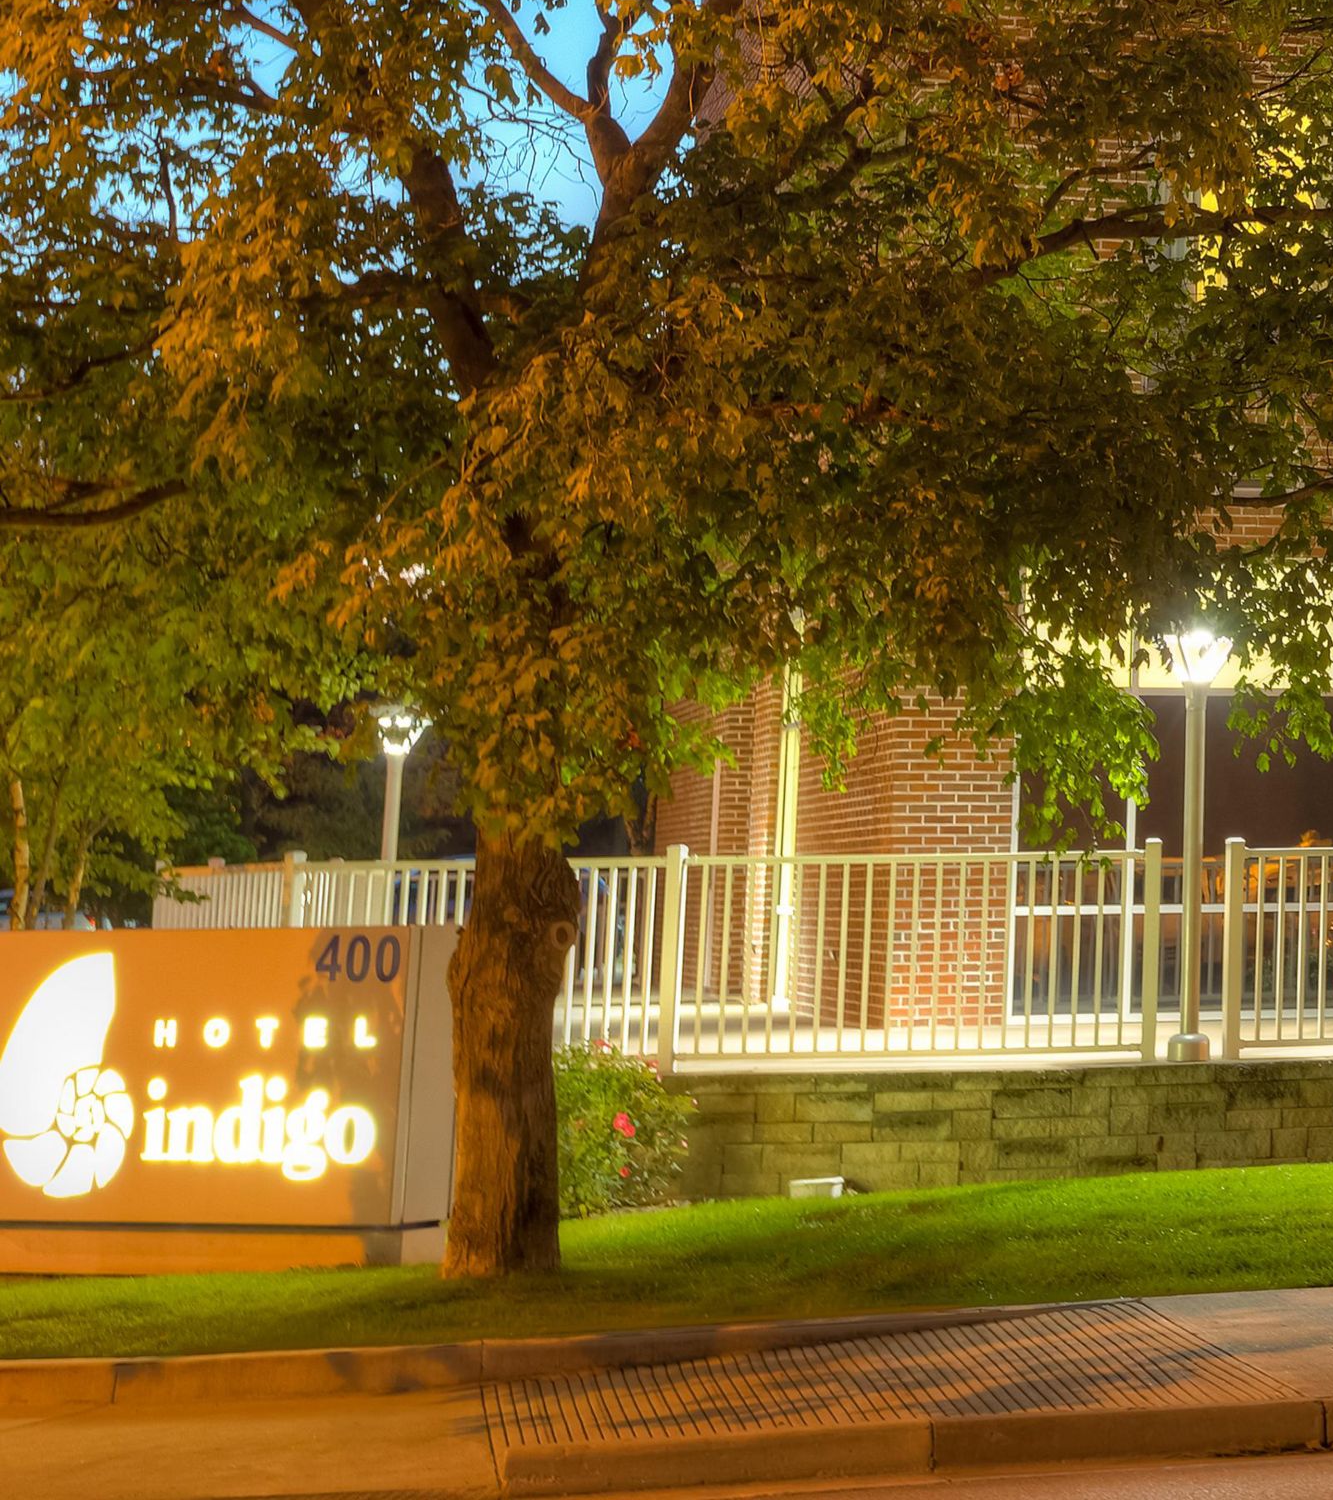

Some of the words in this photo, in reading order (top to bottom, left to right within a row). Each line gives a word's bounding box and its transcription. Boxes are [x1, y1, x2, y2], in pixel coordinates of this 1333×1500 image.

[315, 934, 401, 983] 400
[153, 1015, 378, 1050] HOTEL
[140, 1072, 377, 1182] indigo
